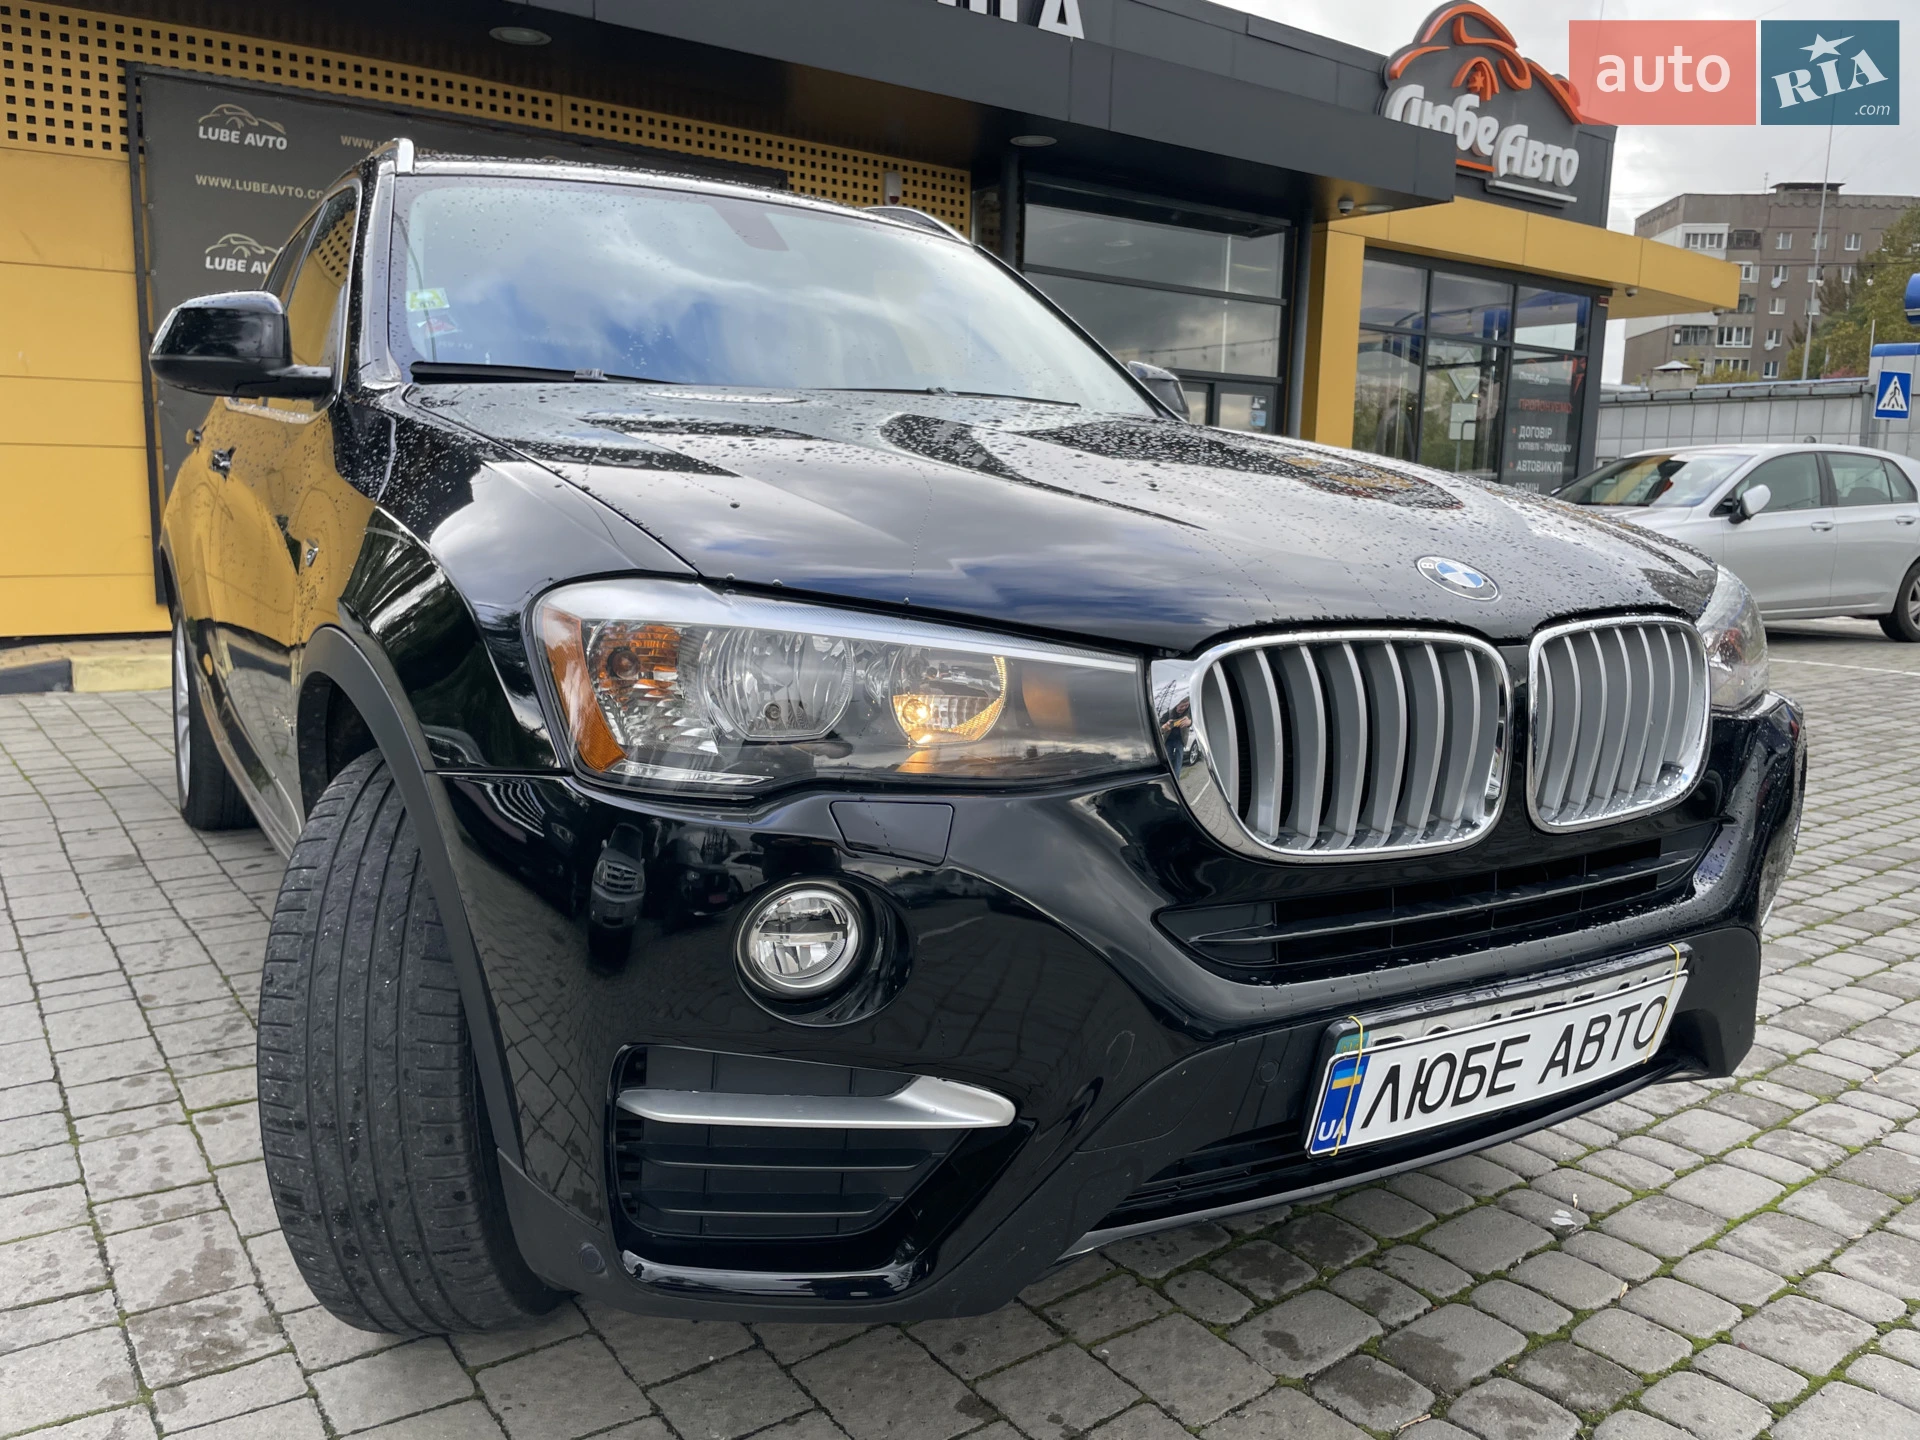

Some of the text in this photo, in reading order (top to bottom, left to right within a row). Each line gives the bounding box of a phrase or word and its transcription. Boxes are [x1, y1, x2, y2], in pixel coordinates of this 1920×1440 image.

[198, 125, 288, 151] LUBE AVTO
[1492, 123, 1580, 188] Авто
[195, 174, 324, 200] WWW.LUBEAVTO.C
[205, 256, 273, 275] LUBE AV
[1518, 425, 1553, 440] ДОГОВІР
[1515, 459, 1563, 473] АВТОВИКУП
[1360, 1034, 1531, 1130] ЛЮБЕ
[1537, 994, 1669, 1085] АВТО
[1317, 1117, 1349, 1142] UA
